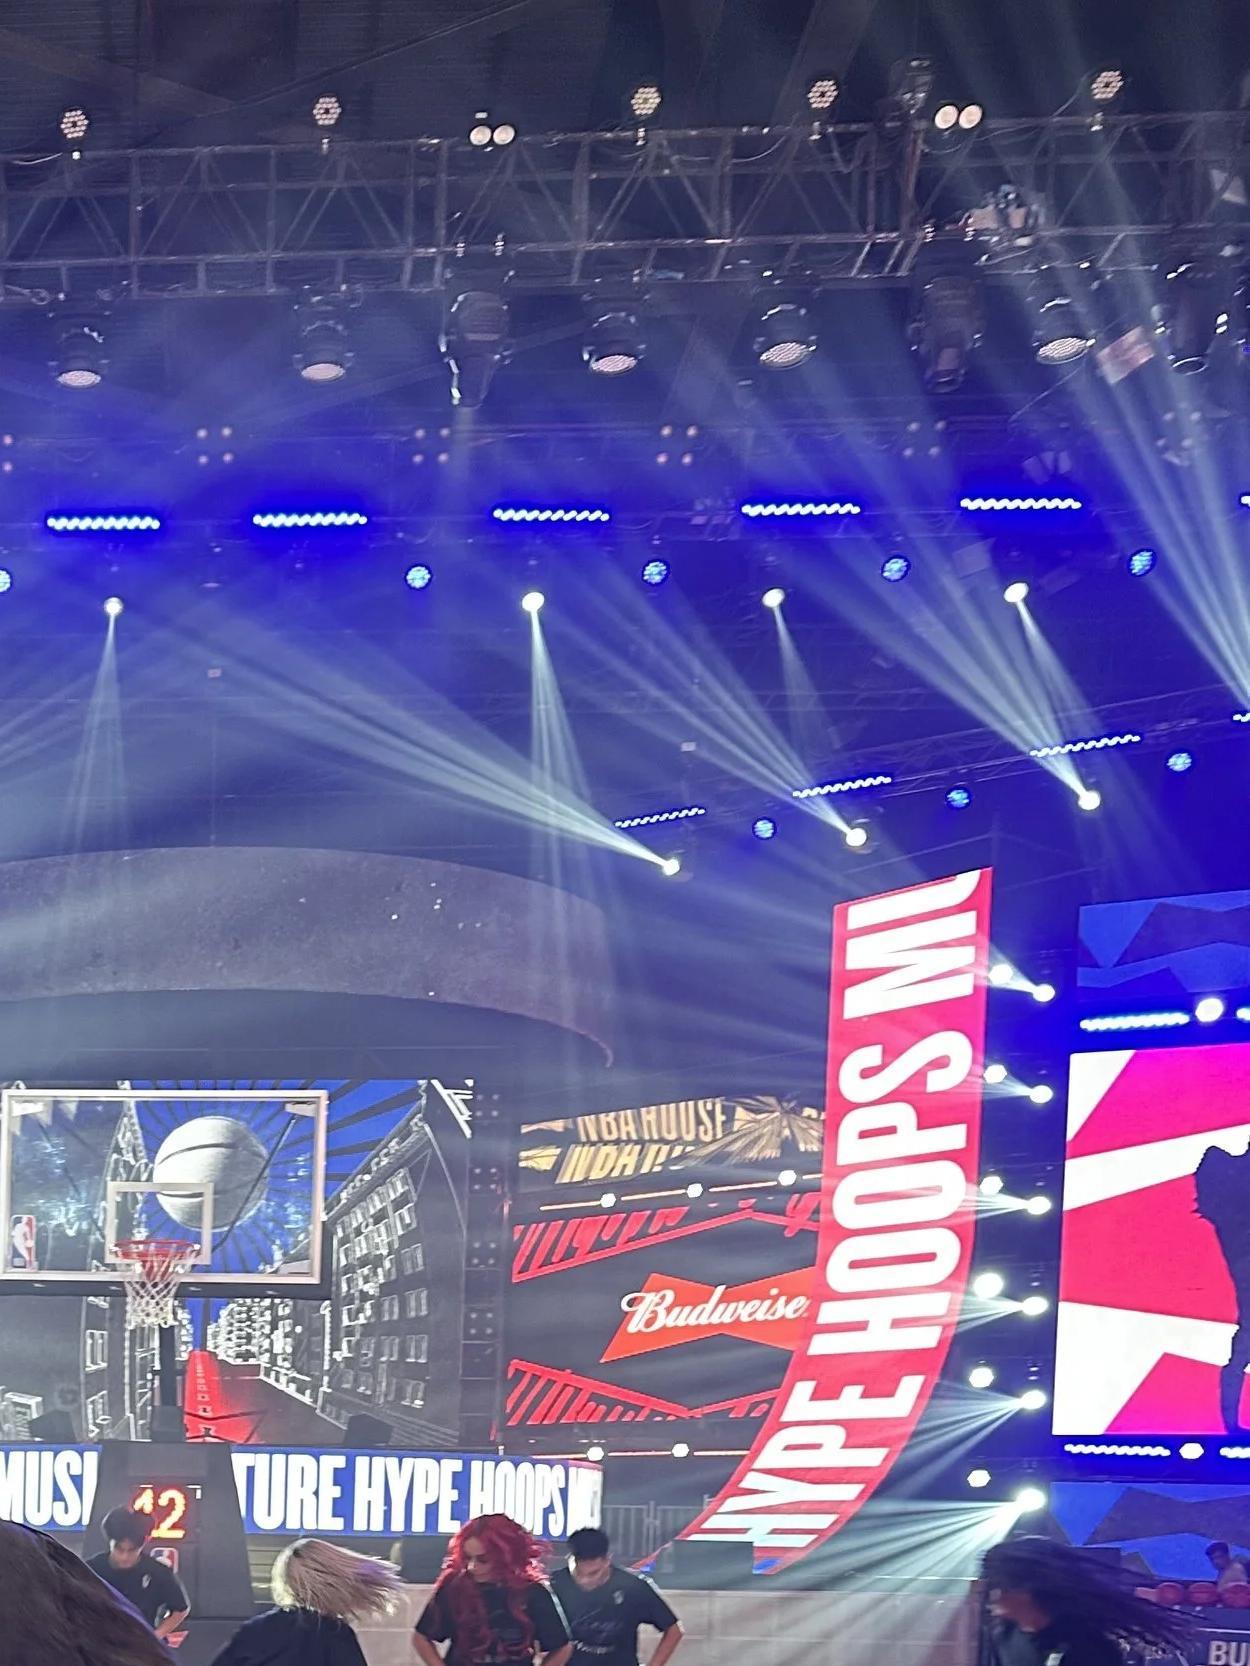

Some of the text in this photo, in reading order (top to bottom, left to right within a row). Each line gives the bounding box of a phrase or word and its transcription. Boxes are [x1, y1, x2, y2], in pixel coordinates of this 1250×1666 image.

[620, 1285, 811, 1334] Budweise
[686, 1375, 926, 1548] HYPE
[807, 1031, 973, 1356] HOOPS
[353, 1456, 462, 1533] HYPE
[470, 1460, 566, 1537] HOOPS
[1208, 1640, 1250, 1666] BU
